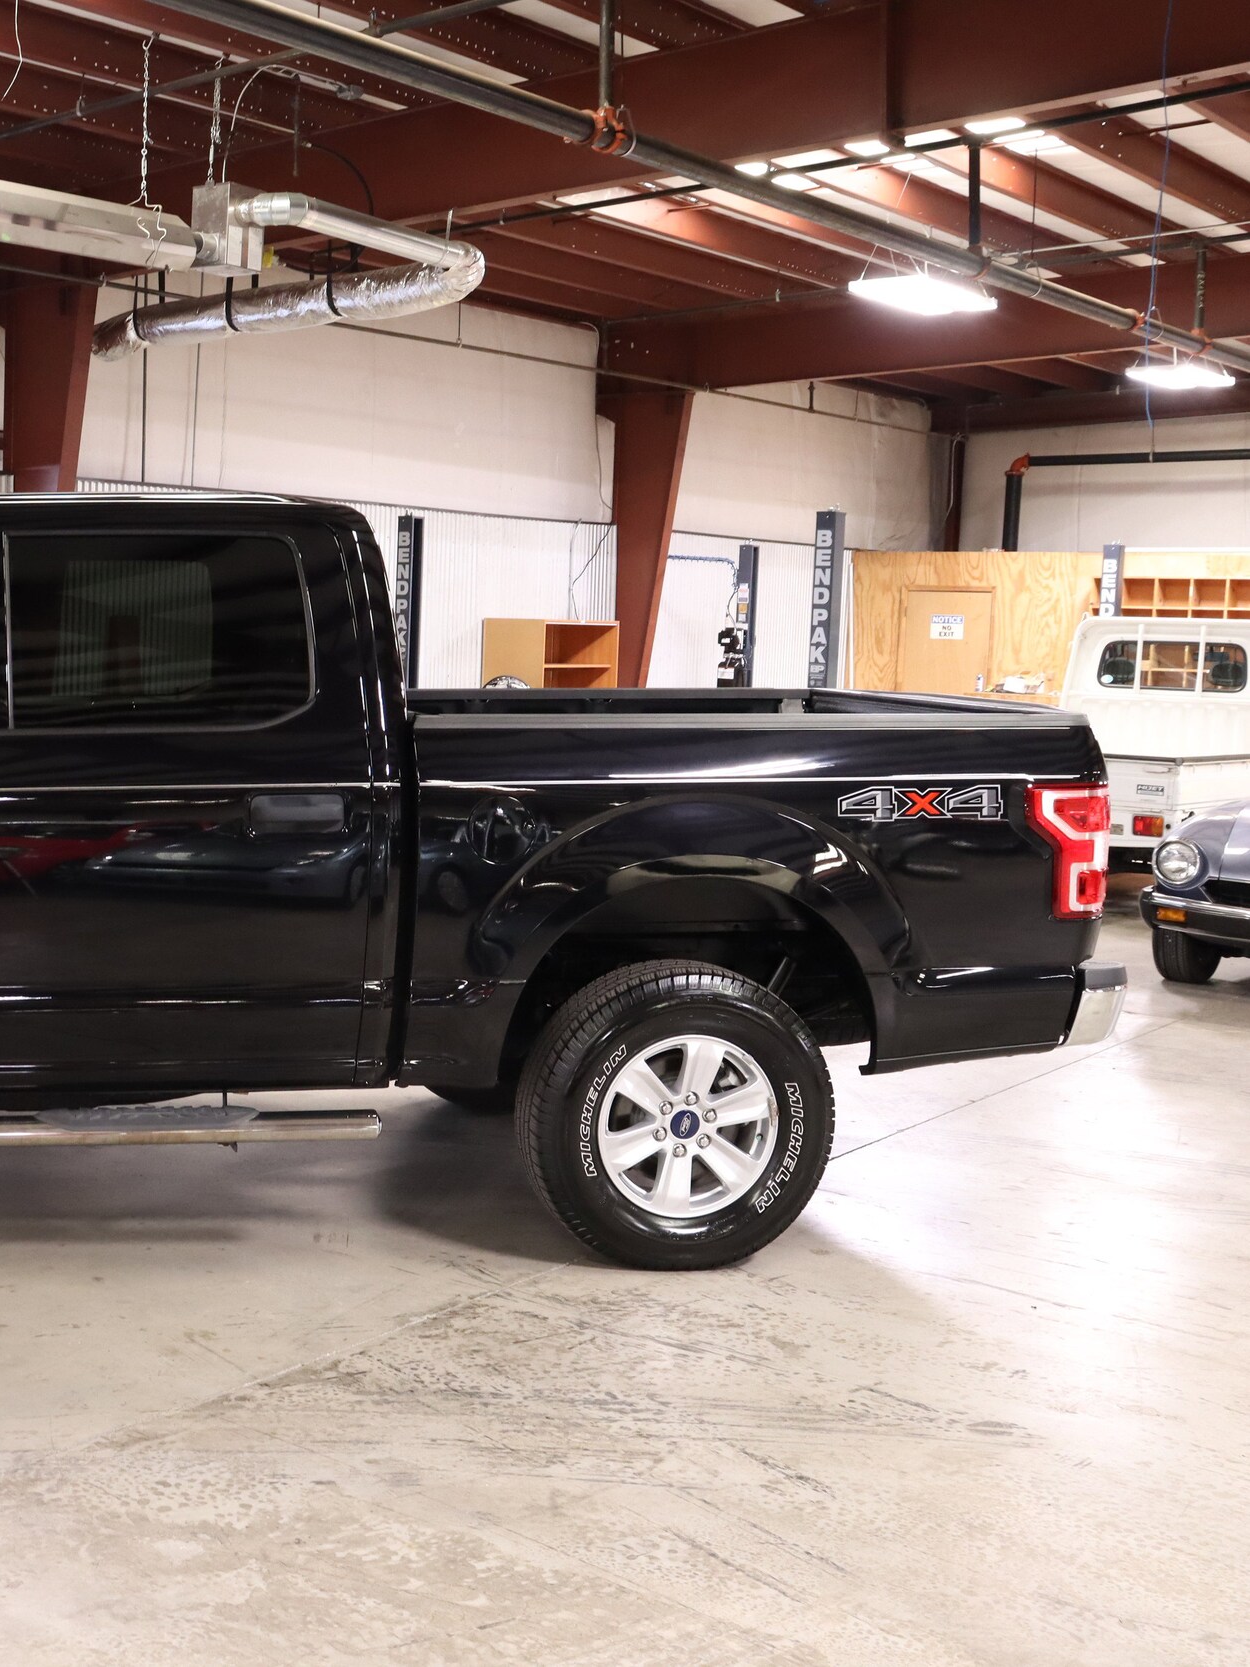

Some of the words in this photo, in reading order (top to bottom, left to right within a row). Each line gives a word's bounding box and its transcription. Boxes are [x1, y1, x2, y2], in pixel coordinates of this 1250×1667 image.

[396, 531, 411, 646] BENDPAK
[810, 529, 833, 663] BENDPAK
[932, 615, 964, 624] NOTICE
[580, 1044, 628, 1178] MICHELIN
[754, 1082, 805, 1214] MICHELIN
